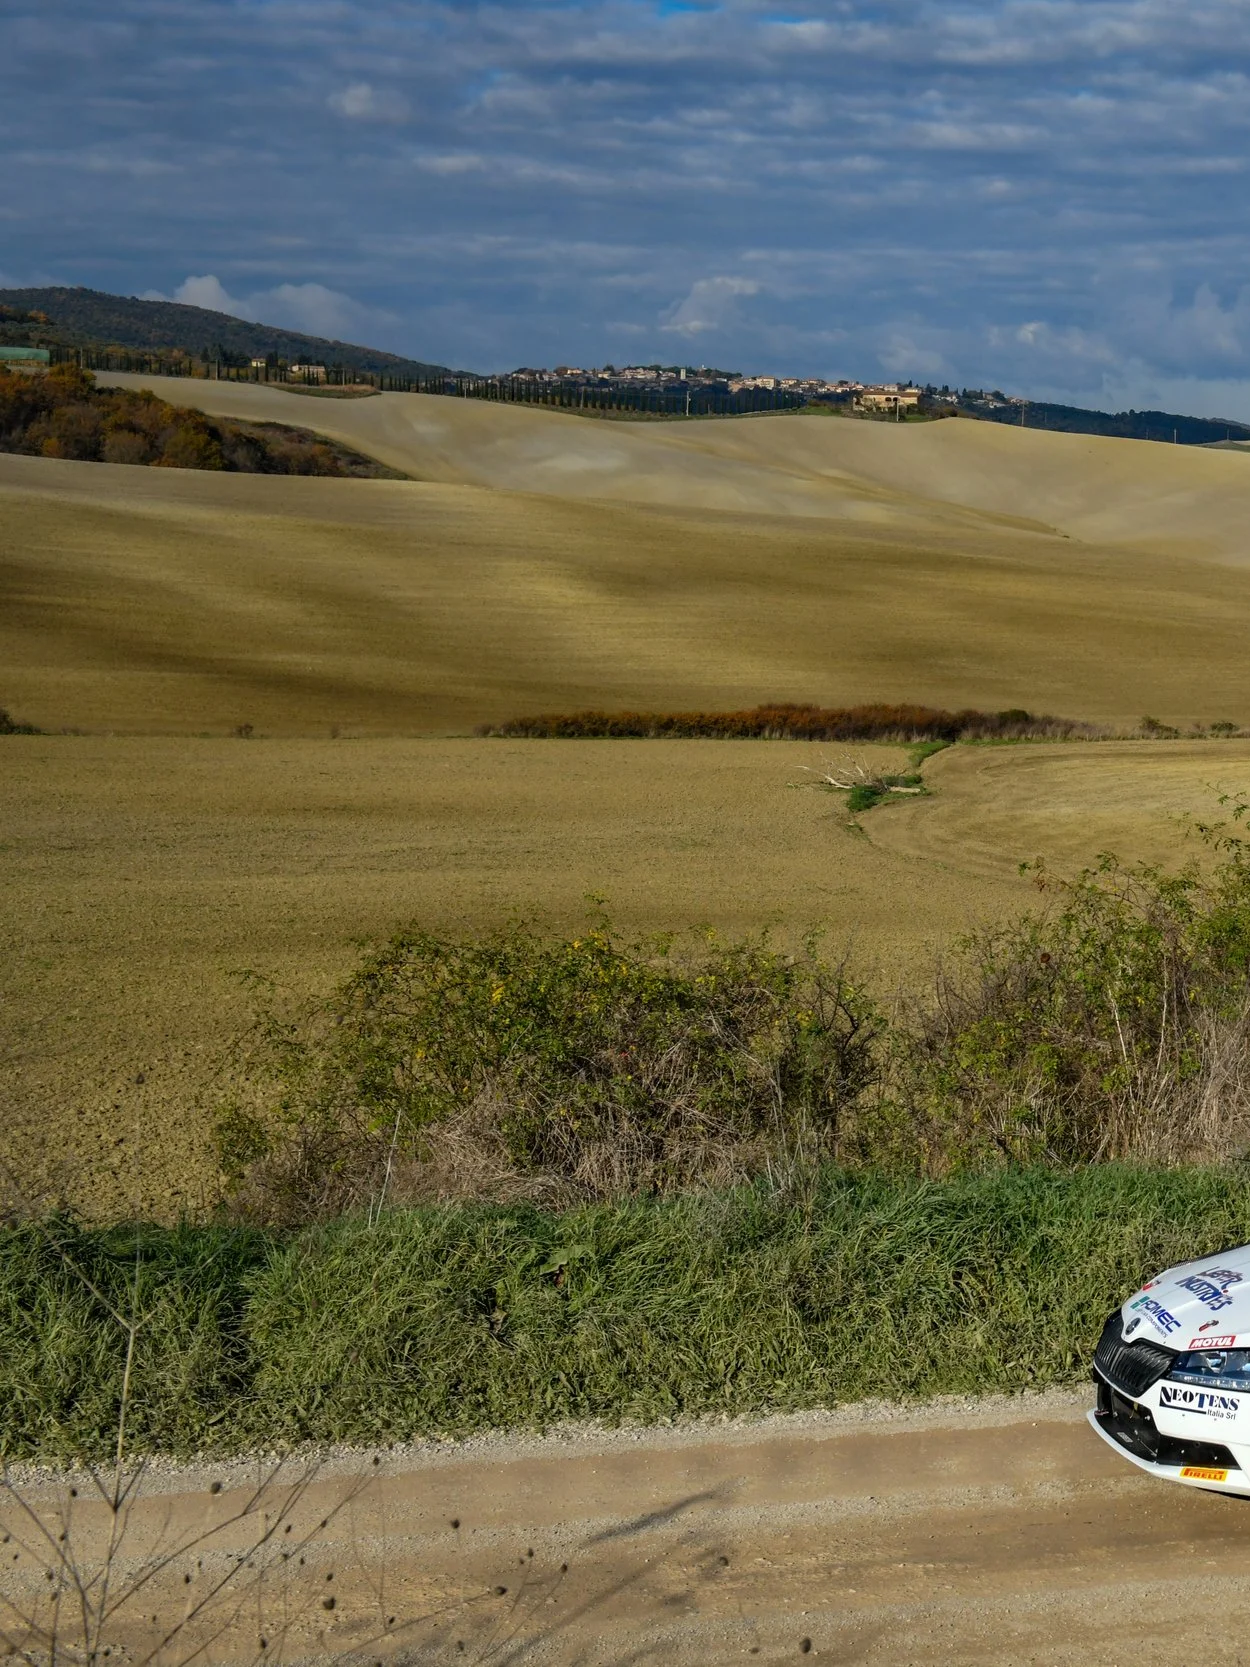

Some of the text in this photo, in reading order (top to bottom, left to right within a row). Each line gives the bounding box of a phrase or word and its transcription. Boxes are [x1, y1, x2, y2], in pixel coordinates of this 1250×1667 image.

[1191, 1336, 1233, 1348] MOTUL
[1159, 1386, 1240, 1411] NEOTENS
[1207, 1409, 1237, 1420] Italia Srl
[1183, 1468, 1225, 1480] PIRELLI
